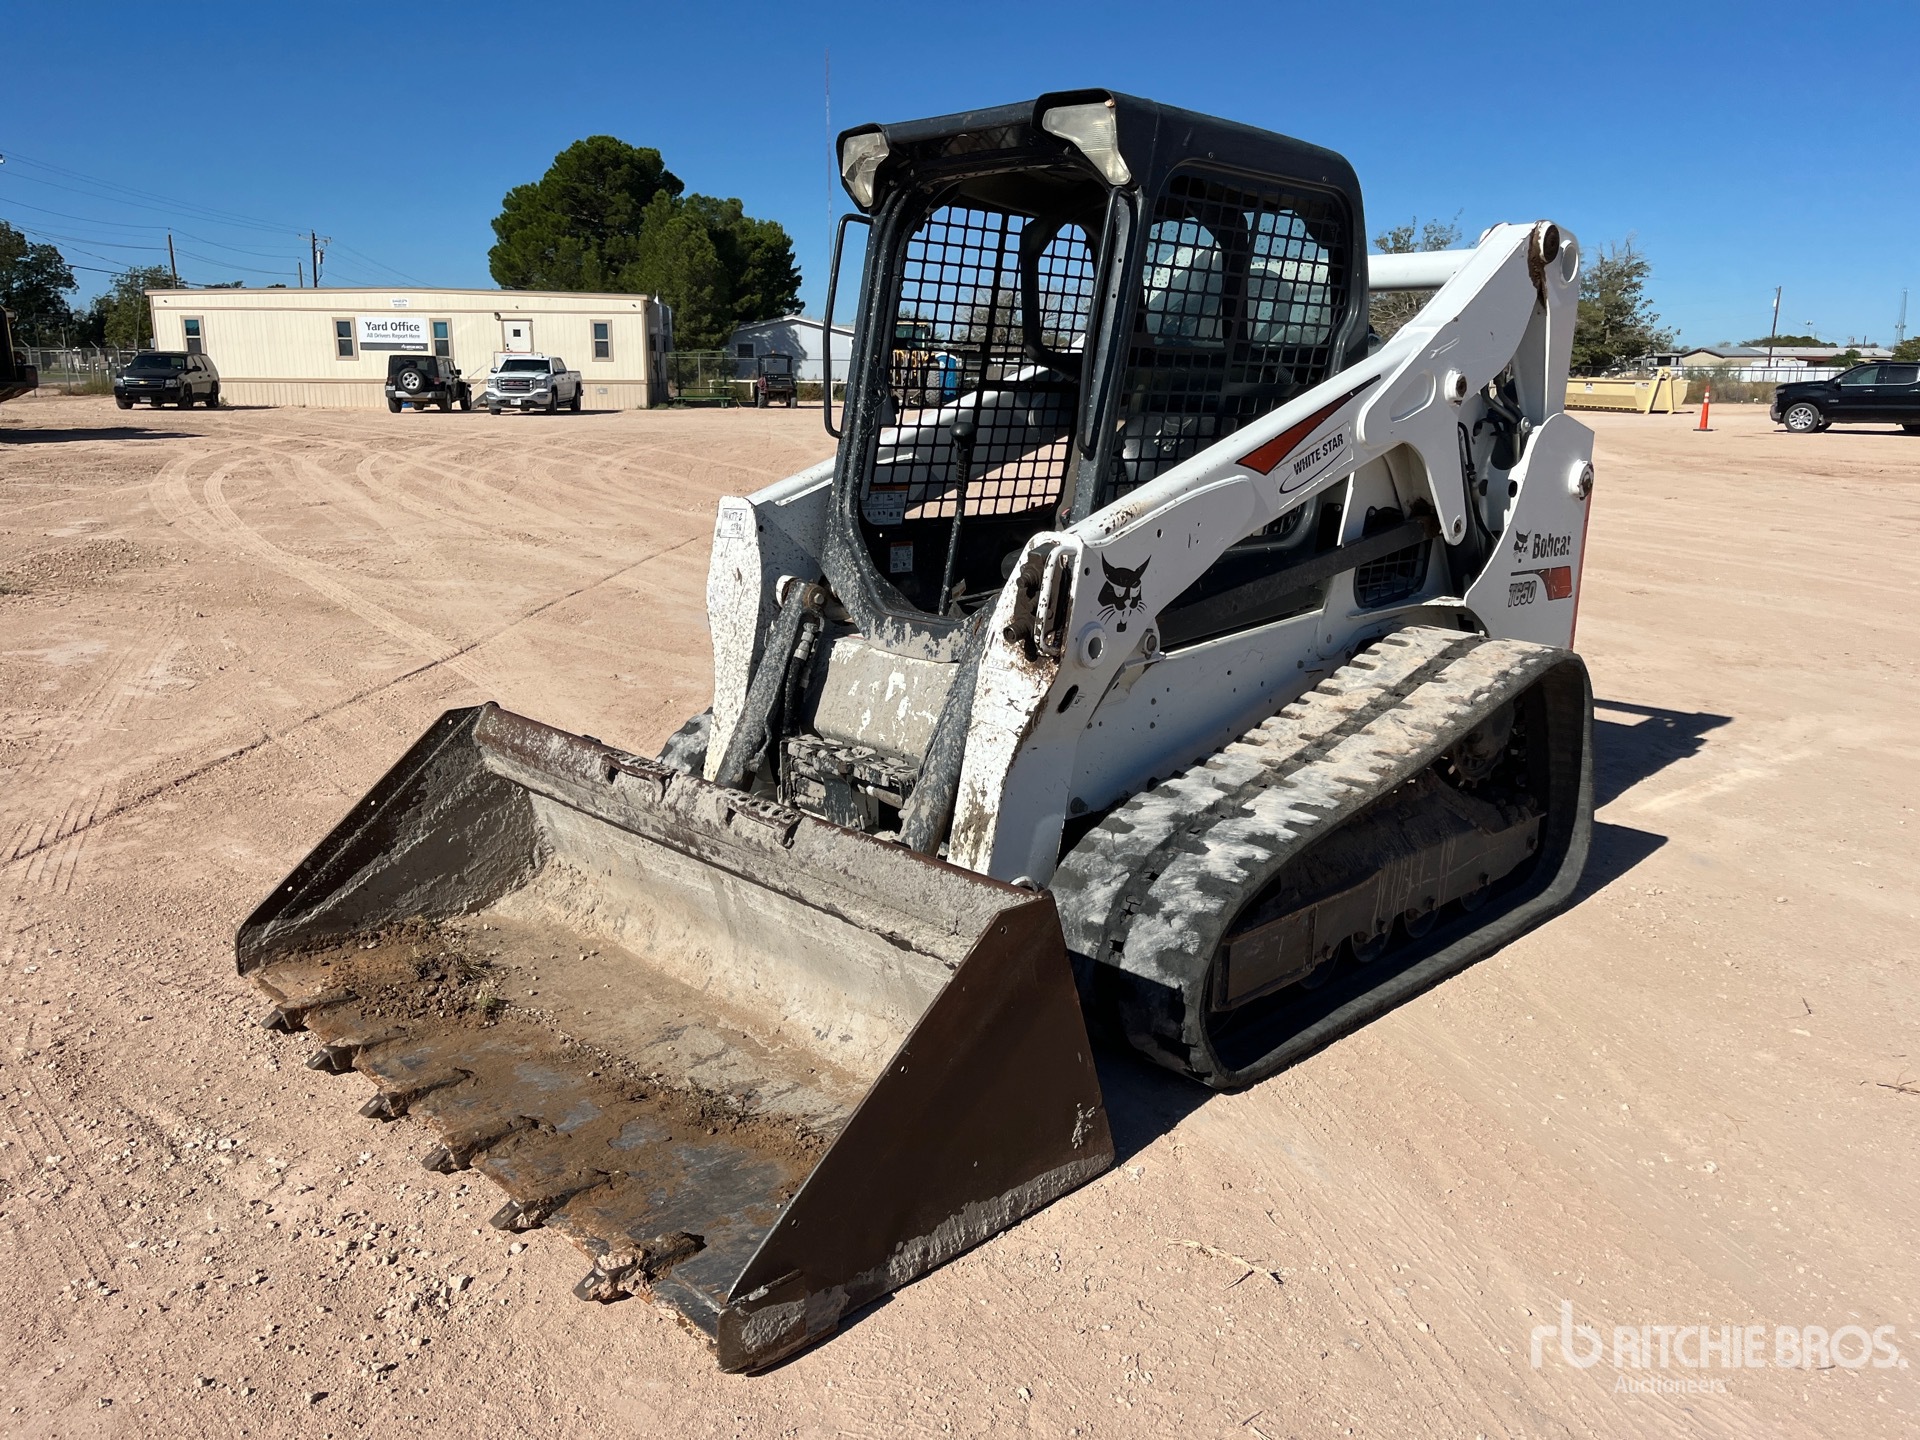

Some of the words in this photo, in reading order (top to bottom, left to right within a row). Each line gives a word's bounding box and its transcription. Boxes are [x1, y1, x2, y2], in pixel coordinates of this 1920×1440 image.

[365, 321, 387, 331] Yard
[390, 321, 420, 331] Office
[1293, 447, 1322, 475] WHITE
[1322, 433, 1344, 457] STAR
[1508, 580, 1537, 608] T650
